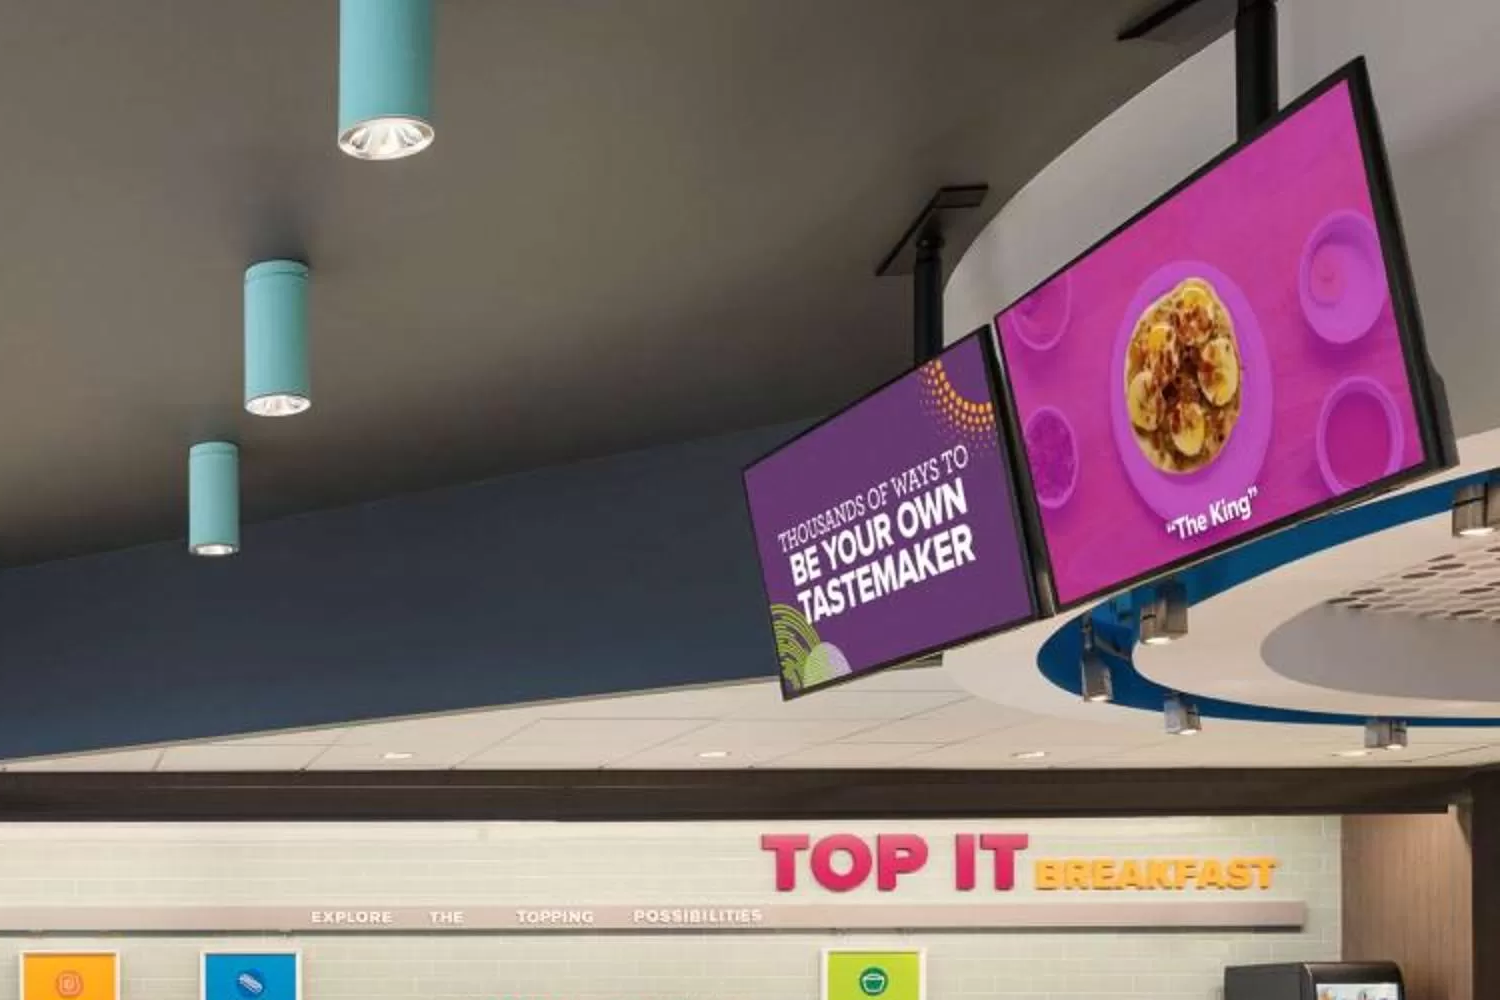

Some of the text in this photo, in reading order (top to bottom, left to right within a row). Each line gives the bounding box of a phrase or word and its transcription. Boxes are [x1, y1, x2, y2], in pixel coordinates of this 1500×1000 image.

[778, 445, 969, 552] THOUSANDS OF WAYS TO
[789, 477, 968, 586] BE YOUR OWN
[797, 523, 976, 625] TASTEMAKER
[761, 833, 1279, 893] TOP IT BREAKFAST
[311, 908, 763, 924] EXPLORE THE TOPPING POSSIBILITIES
